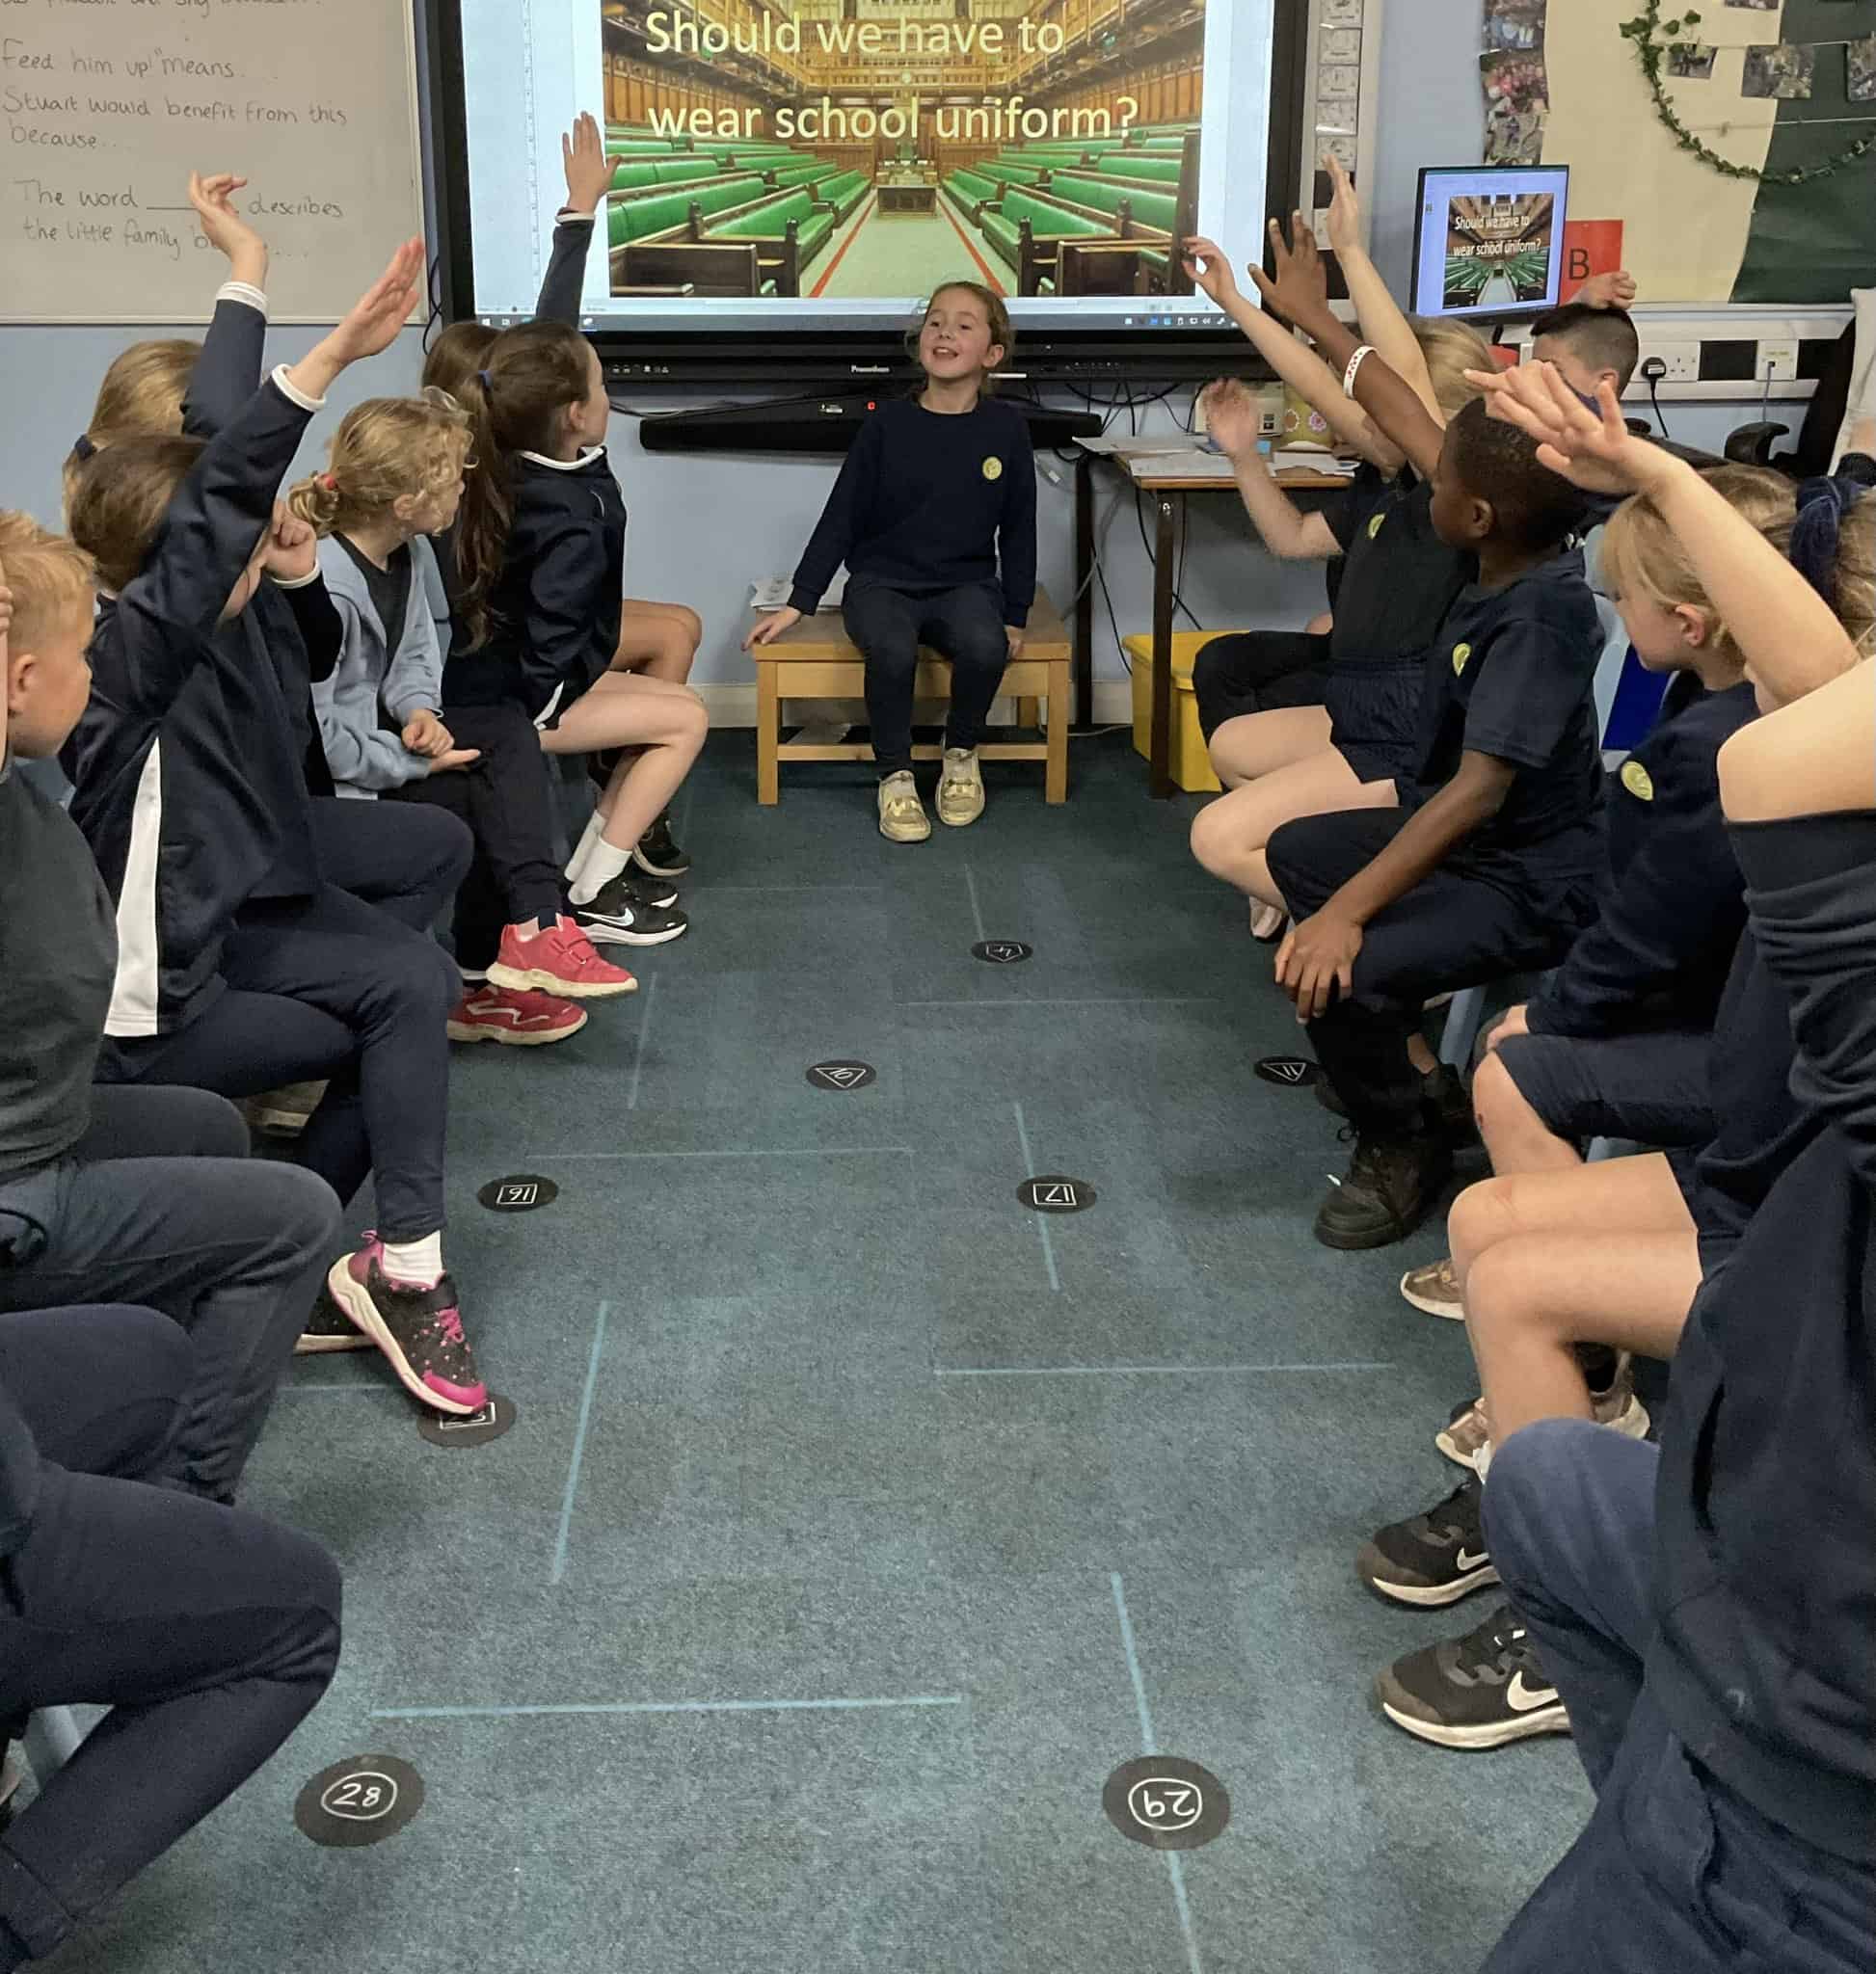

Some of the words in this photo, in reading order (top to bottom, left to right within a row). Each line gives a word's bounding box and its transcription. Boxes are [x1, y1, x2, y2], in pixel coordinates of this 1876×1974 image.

[646, 11, 801, 53] Should
[817, 22, 882, 53] we
[898, 16, 1004, 53] have
[1018, 17, 1064, 53] to
[70, 47, 114, 74] him
[2, 93, 78, 113] Stuart
[166, 96, 236, 120] benefit
[308, 99, 348, 125] this
[648, 106, 762, 138] wear
[775, 96, 919, 139] school
[936, 96, 1138, 139] uniform?
[13, 178, 64, 205] The
[78, 185, 138, 206] word
[248, 193, 343, 218] describes
[1455, 215, 1486, 230] Should
[1521, 214, 1530, 227] to
[23, 218, 58, 241] the
[66, 220, 112, 241] little
[123, 218, 181, 260] family
[1453, 243, 1475, 256] wear
[1476, 238, 1503, 254] school
[1505, 237, 1541, 253] uniform?
[1569, 248, 1590, 280] B
[332, 1782, 383, 1808] 28
[1142, 1789, 1196, 1818] 29
